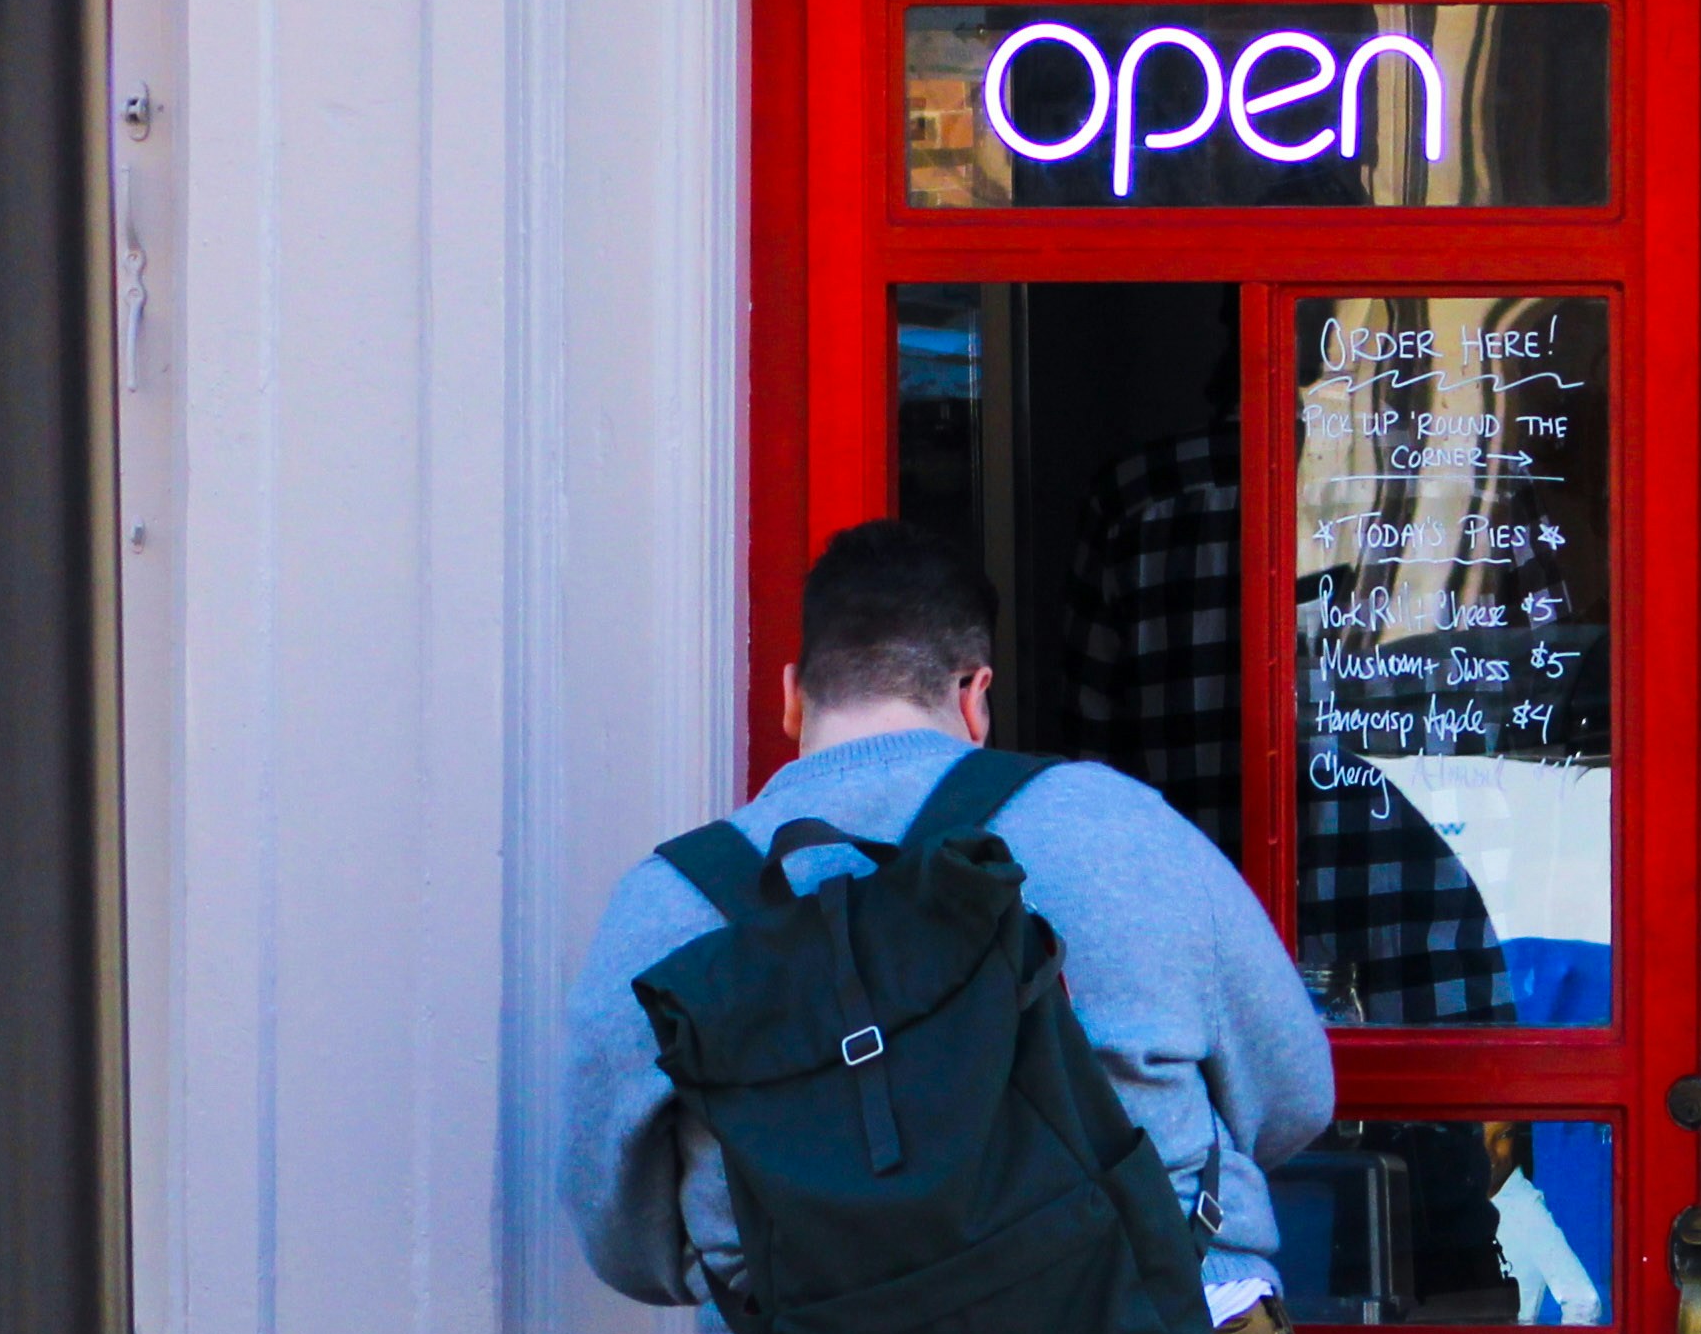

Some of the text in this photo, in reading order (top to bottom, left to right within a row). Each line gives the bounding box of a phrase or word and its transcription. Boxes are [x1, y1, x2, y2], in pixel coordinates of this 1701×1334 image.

[983, 22, 1444, 198] open
[1320, 314, 1558, 371] ORDER HERE!
[1303, 405, 1354, 438] PICK
[1362, 411, 1399, 437] UP
[1516, 416, 1569, 438] THE
[1391, 445, 1487, 468] CORNER
[1336, 512, 1528, 550] TODAY'S PIES
[1319, 574, 1366, 629] Pork
[1434, 590, 1509, 631] Cheese
[1521, 591, 1564, 622] $5
[1447, 647, 1511, 686] Swiss
[1530, 641, 1581, 679] $5
[1309, 751, 1390, 820] Cherry
